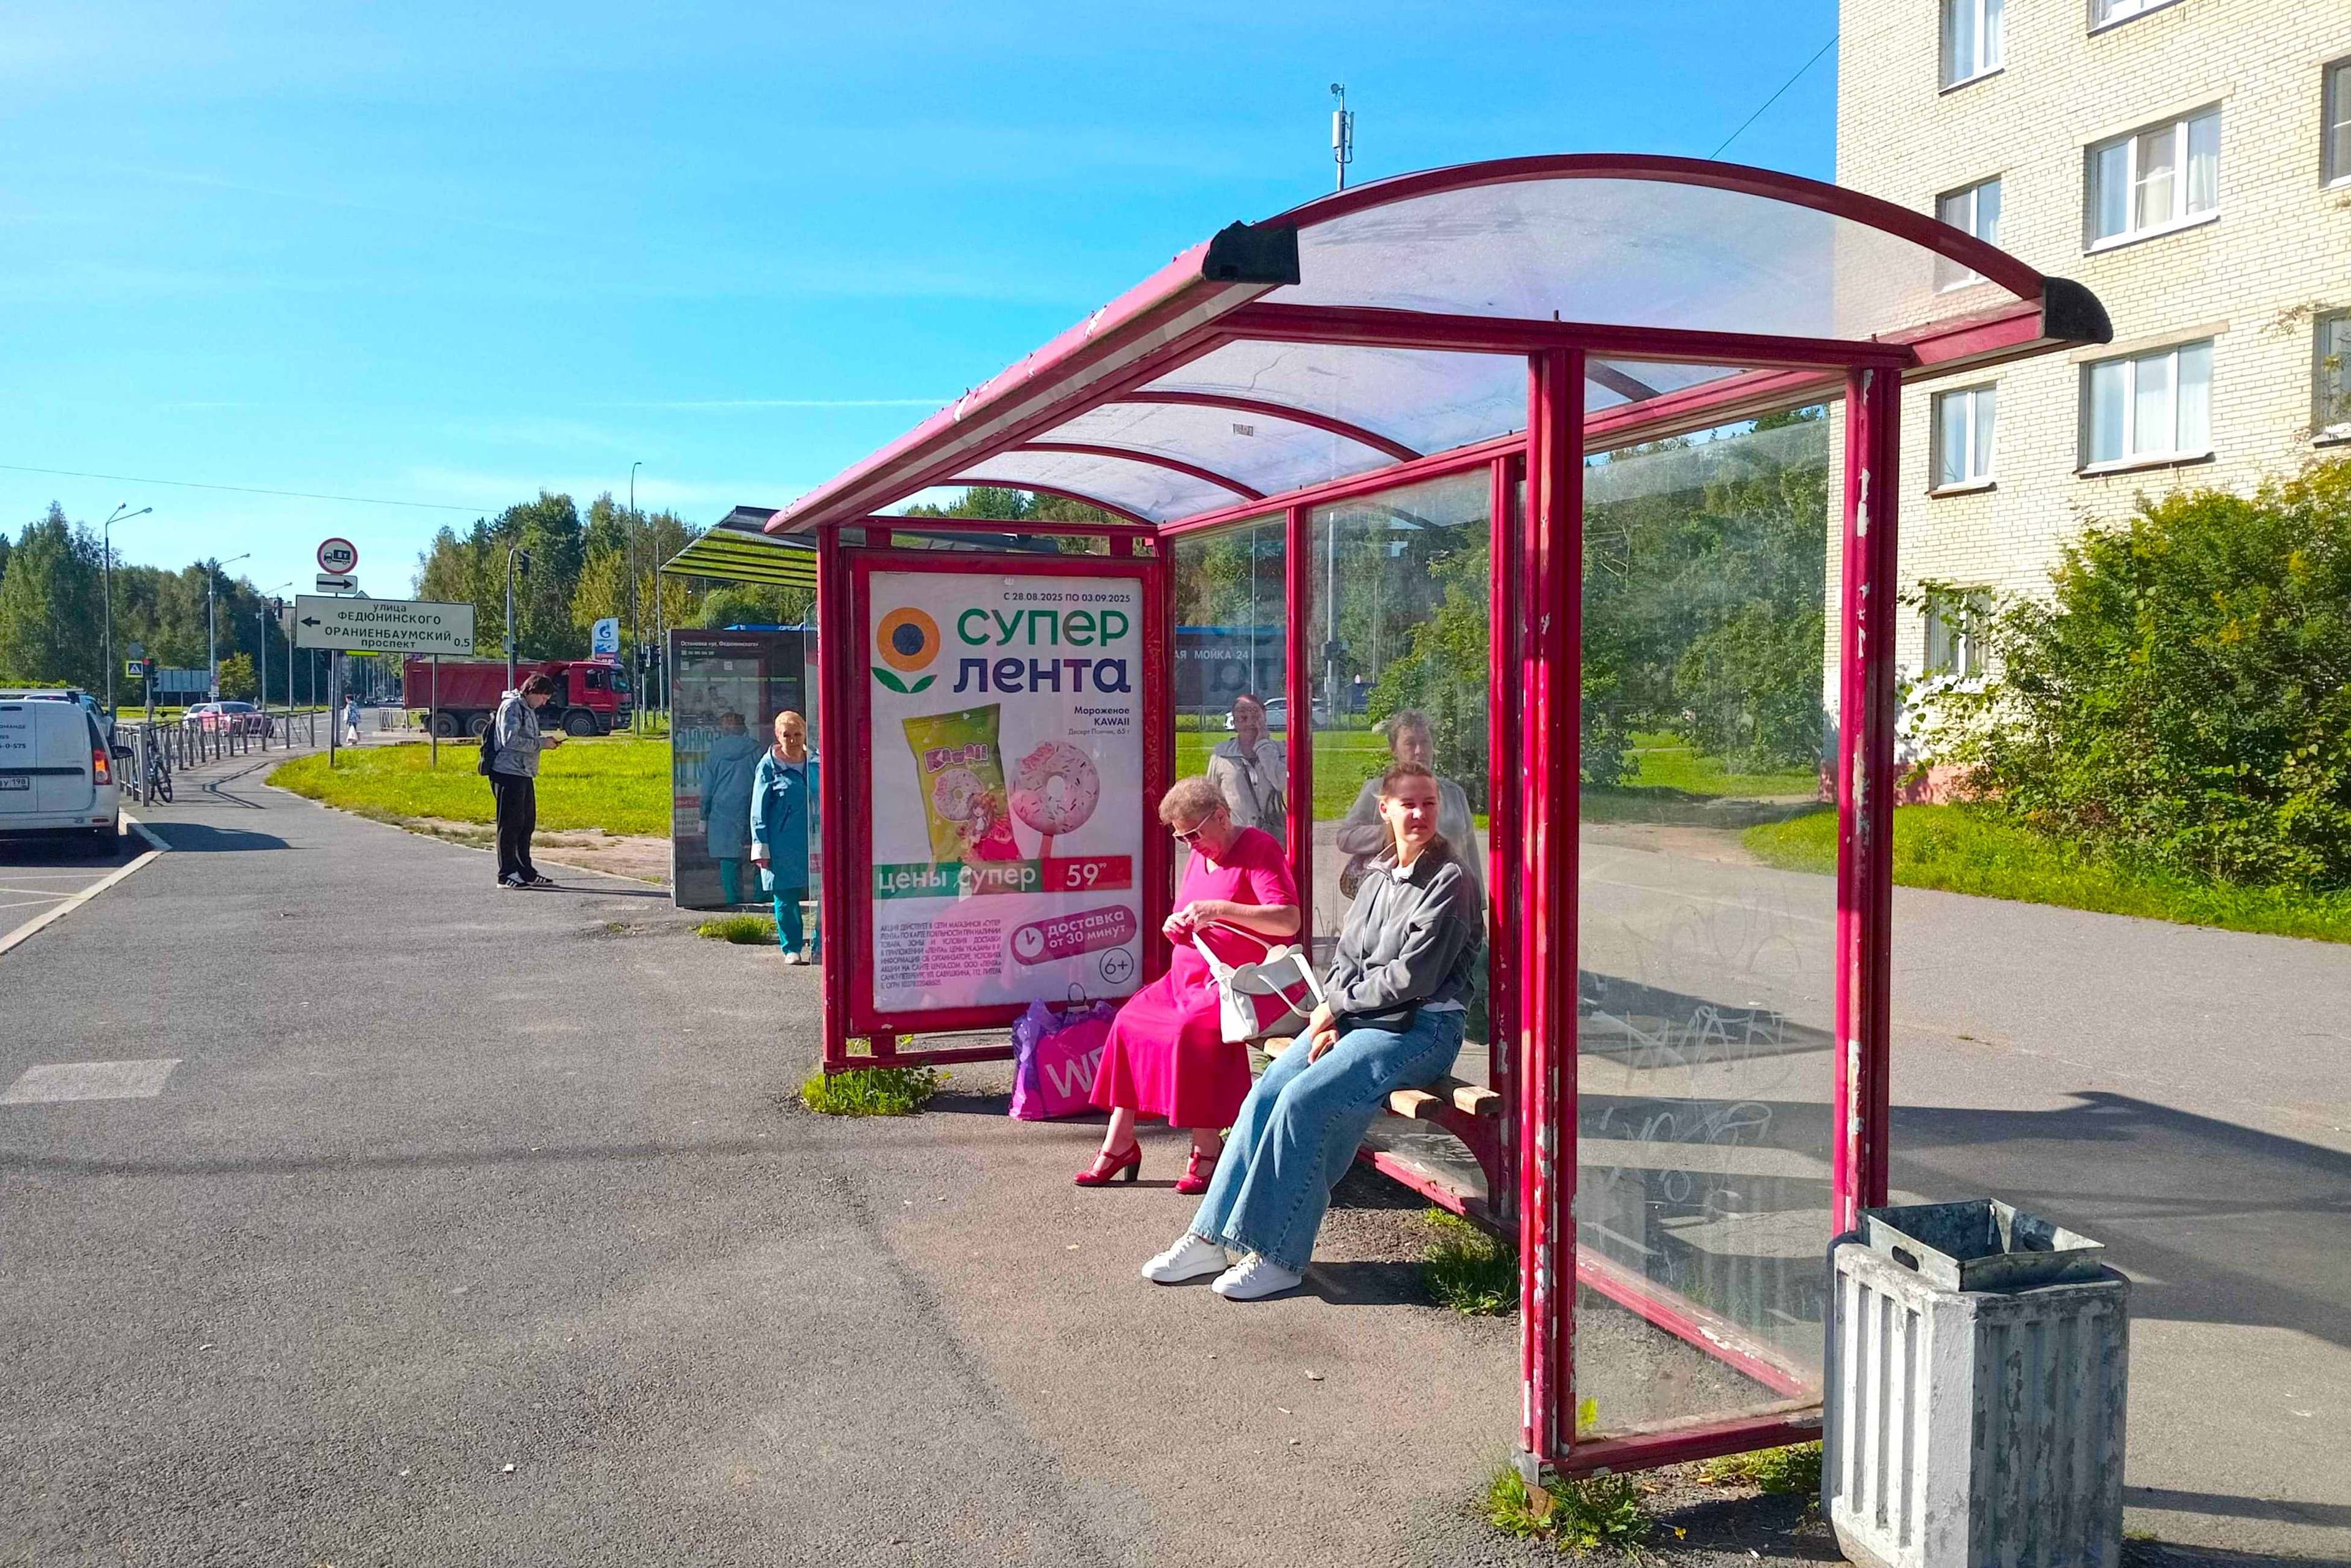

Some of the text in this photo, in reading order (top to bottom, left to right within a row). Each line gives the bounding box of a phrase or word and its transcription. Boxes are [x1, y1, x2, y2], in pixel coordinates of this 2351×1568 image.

[1013, 593, 1063, 601] 28.08.2025
[1065, 593, 1079, 602] ПО
[1082, 594, 1131, 603] 03.09.2025
[373, 602, 407, 613] улица
[337, 611, 441, 625] ФЕДЮНИНСКОГО
[957, 608, 1129, 647] супер
[324, 626, 471, 648] ОРАНИЕНБАУМСКИЙ 0.5
[361, 639, 416, 650] проспект
[1194, 648, 1232, 659] МОЙКА
[1236, 650, 1249, 659] 24
[953, 658, 1131, 693] лента
[1074, 706, 1130, 716] Мороженое
[1094, 718, 1130, 726] KAWAII
[879, 866, 1036, 893] цены супер
[1048, 910, 1125, 938] доставка
[1049, 925, 1126, 948] от 30 минут
[1104, 957, 1128, 975] 6+
